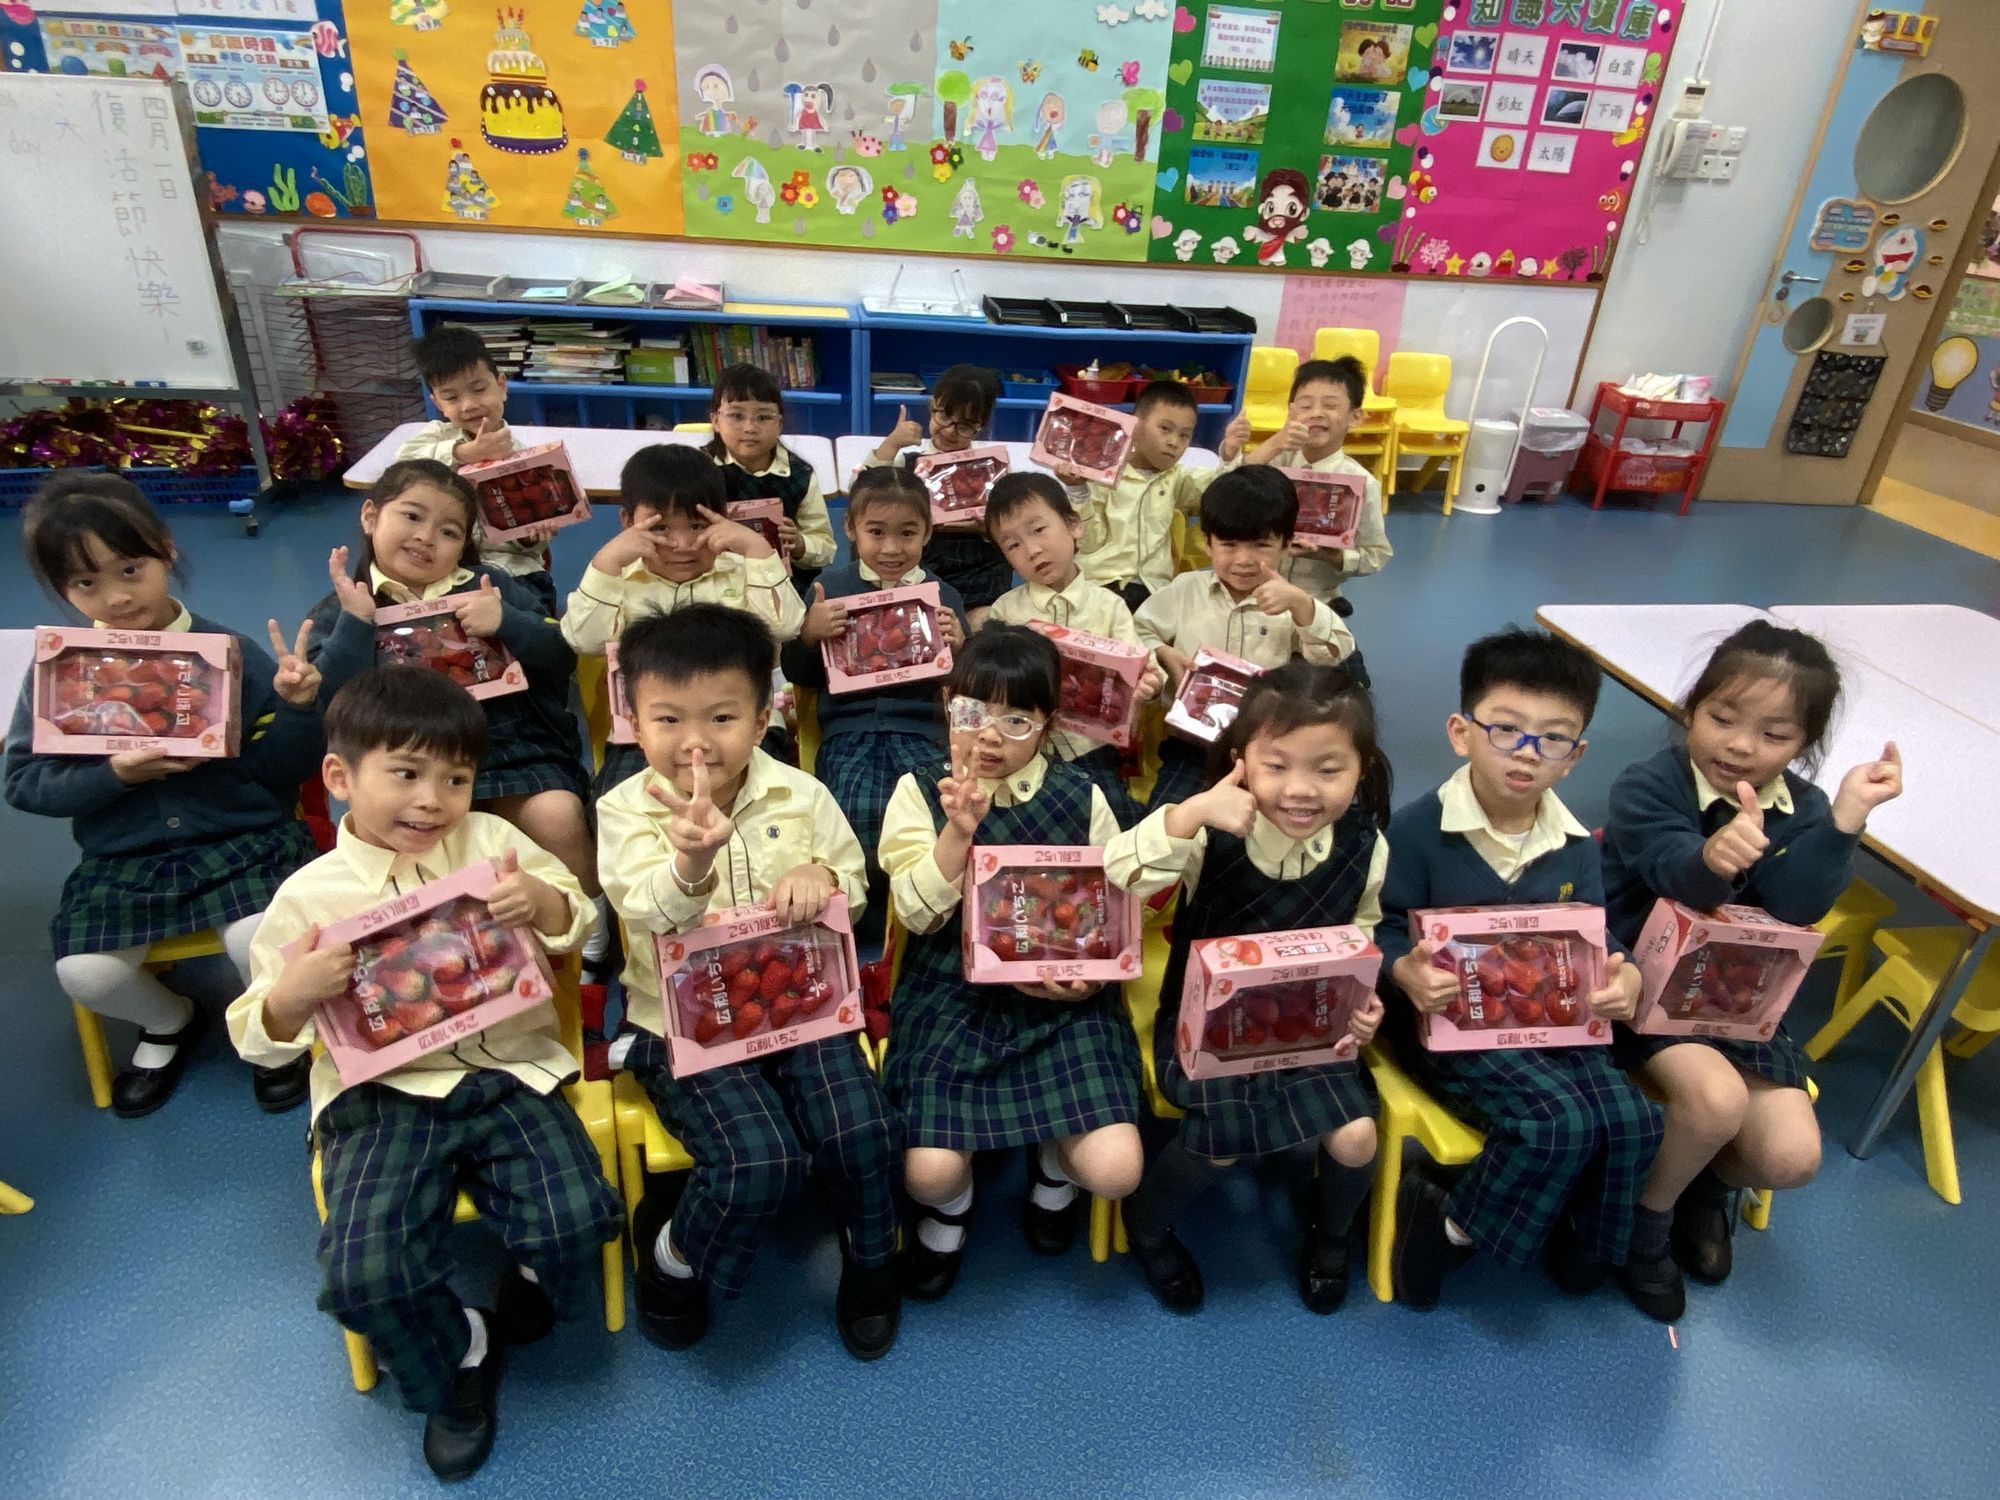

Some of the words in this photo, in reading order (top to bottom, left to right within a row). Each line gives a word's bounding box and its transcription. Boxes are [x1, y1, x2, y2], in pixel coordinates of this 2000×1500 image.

[1507, 48, 1534, 65] 晴天
[1608, 59, 1635, 76] 白雲
[1496, 95, 1523, 111] 彩虹
[1598, 103, 1623, 119] 下雨
[142, 97, 178, 199] 四月一日
[1538, 146, 1565, 162] 太陽
